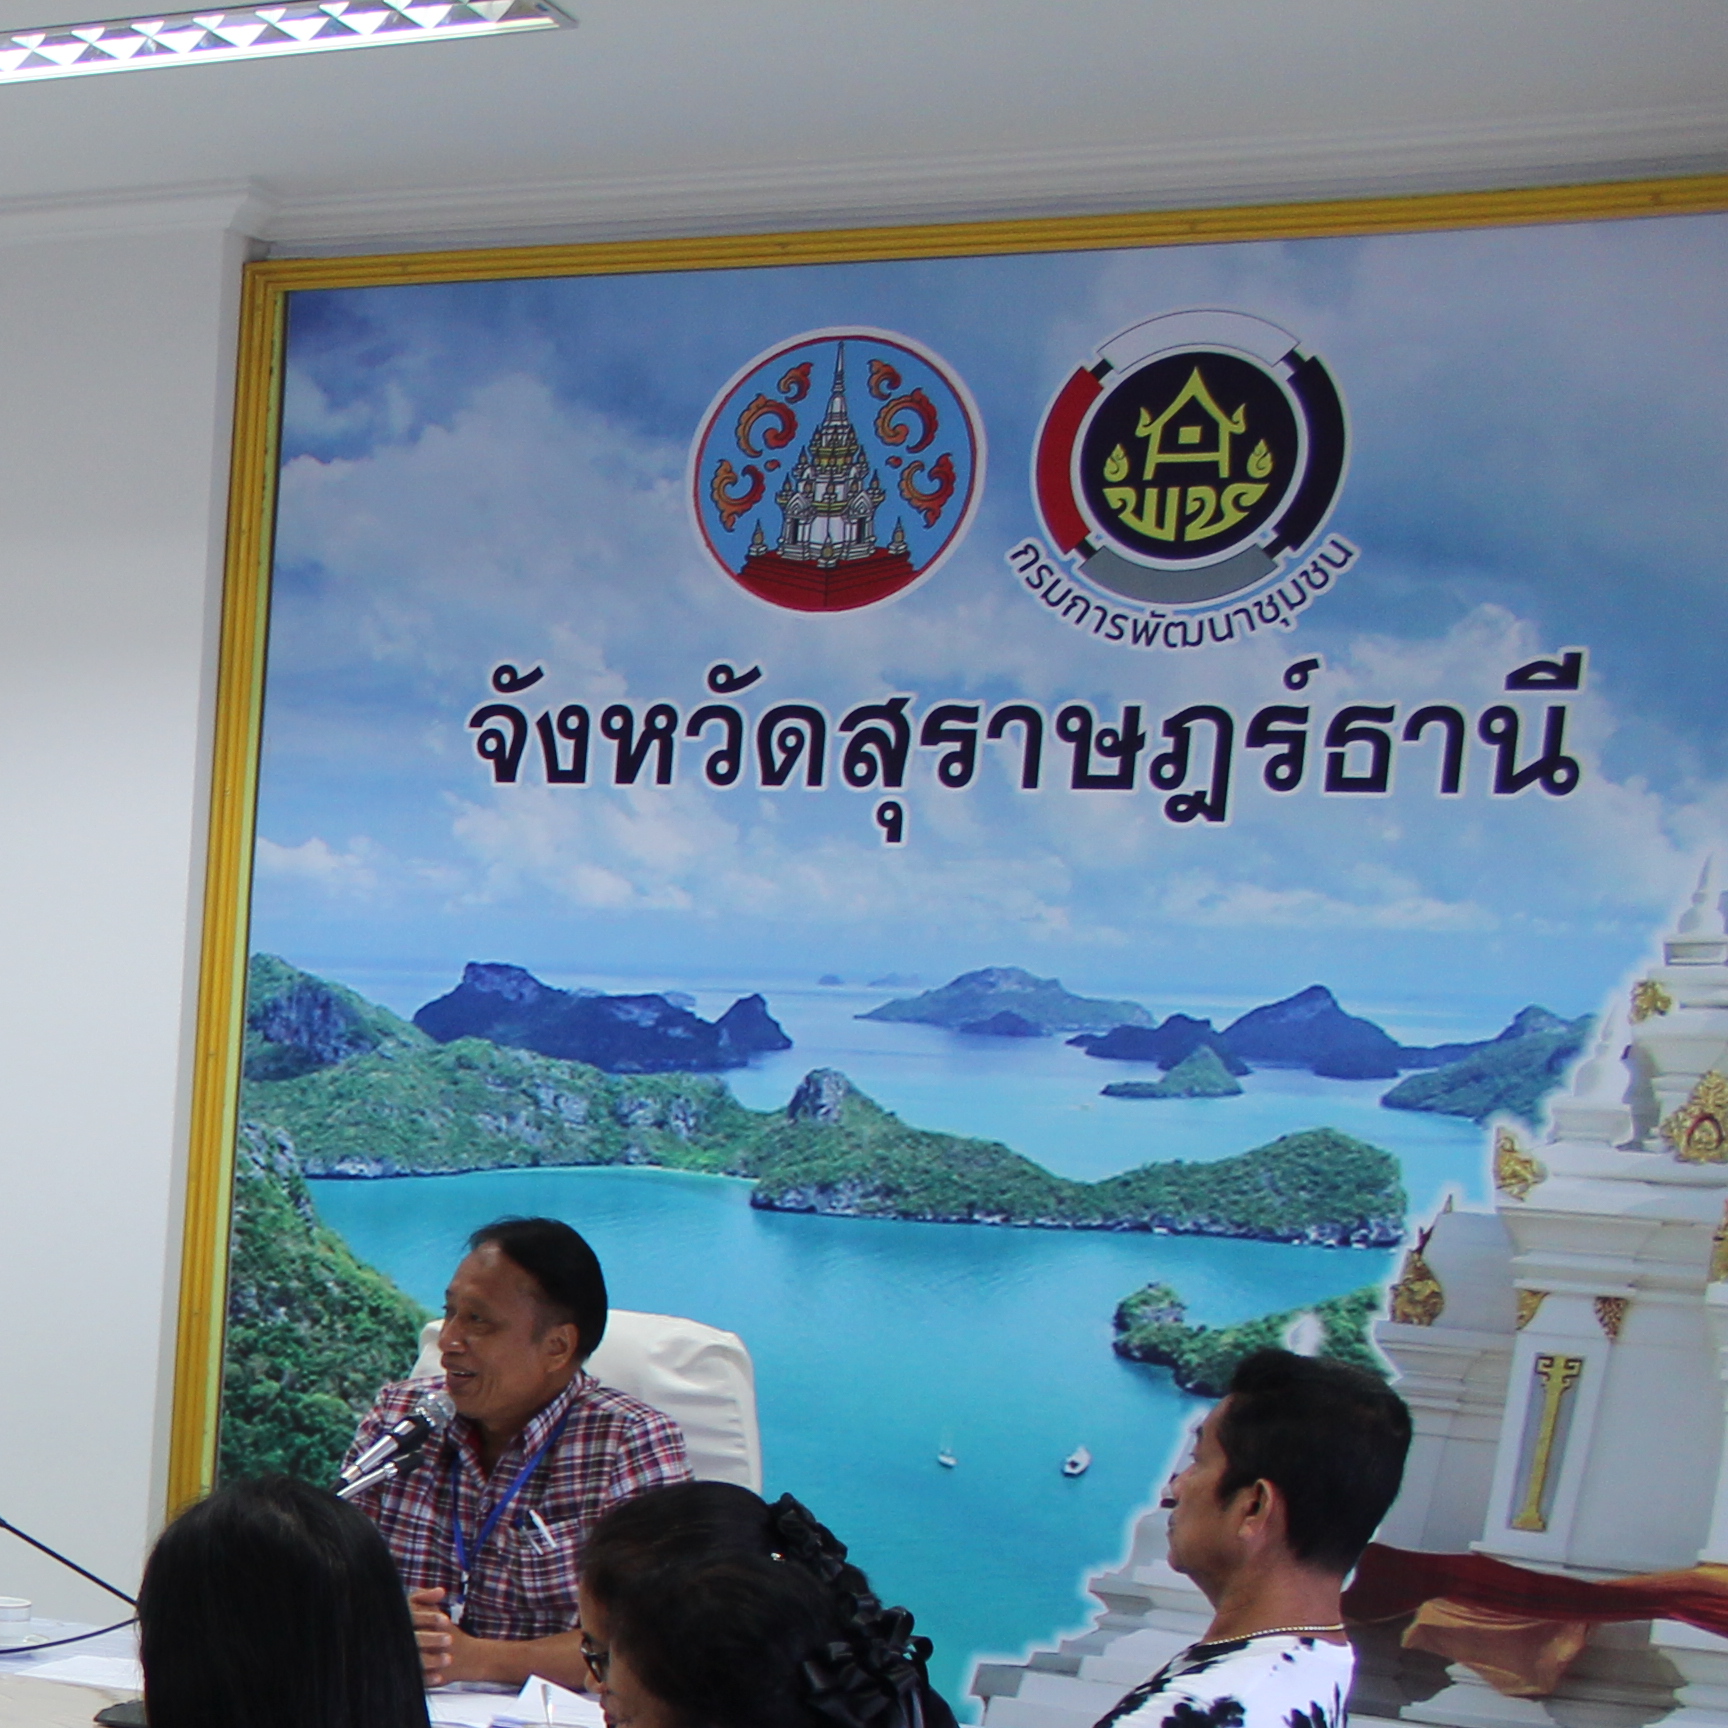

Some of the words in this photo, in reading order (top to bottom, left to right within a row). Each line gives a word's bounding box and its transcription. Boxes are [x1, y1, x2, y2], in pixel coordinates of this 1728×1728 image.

[1010, 541, 1355, 648] กรมการพัฒนาชุมชน
[469, 652, 1584, 843] จังหวัดสุราษฎร์ธานี
